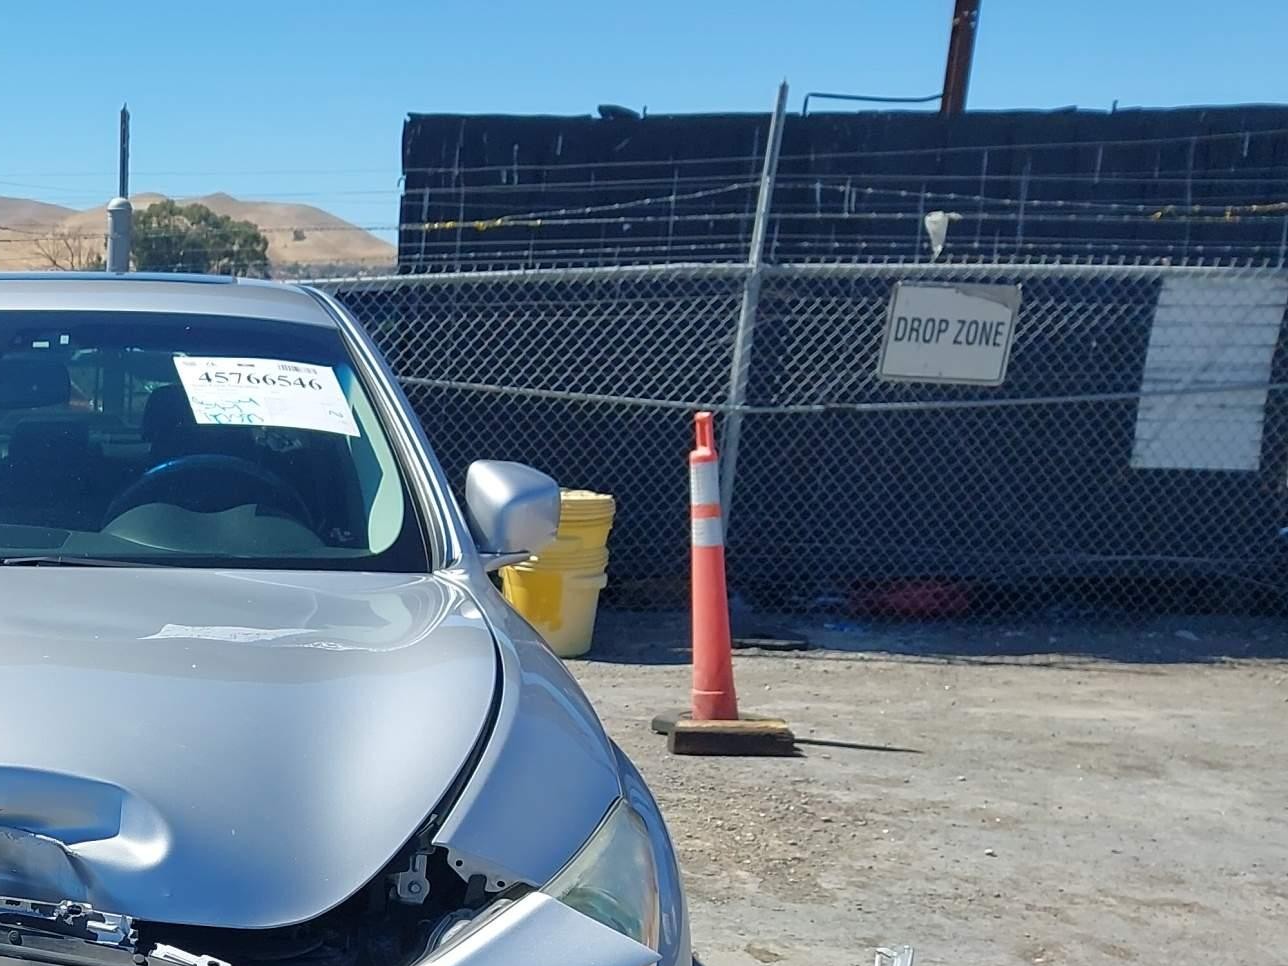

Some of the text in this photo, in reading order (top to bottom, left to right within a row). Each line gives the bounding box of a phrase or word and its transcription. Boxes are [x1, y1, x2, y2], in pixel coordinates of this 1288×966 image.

[893, 316, 1006, 347] DROP ZONE
[198, 371, 323, 391] 45766546
